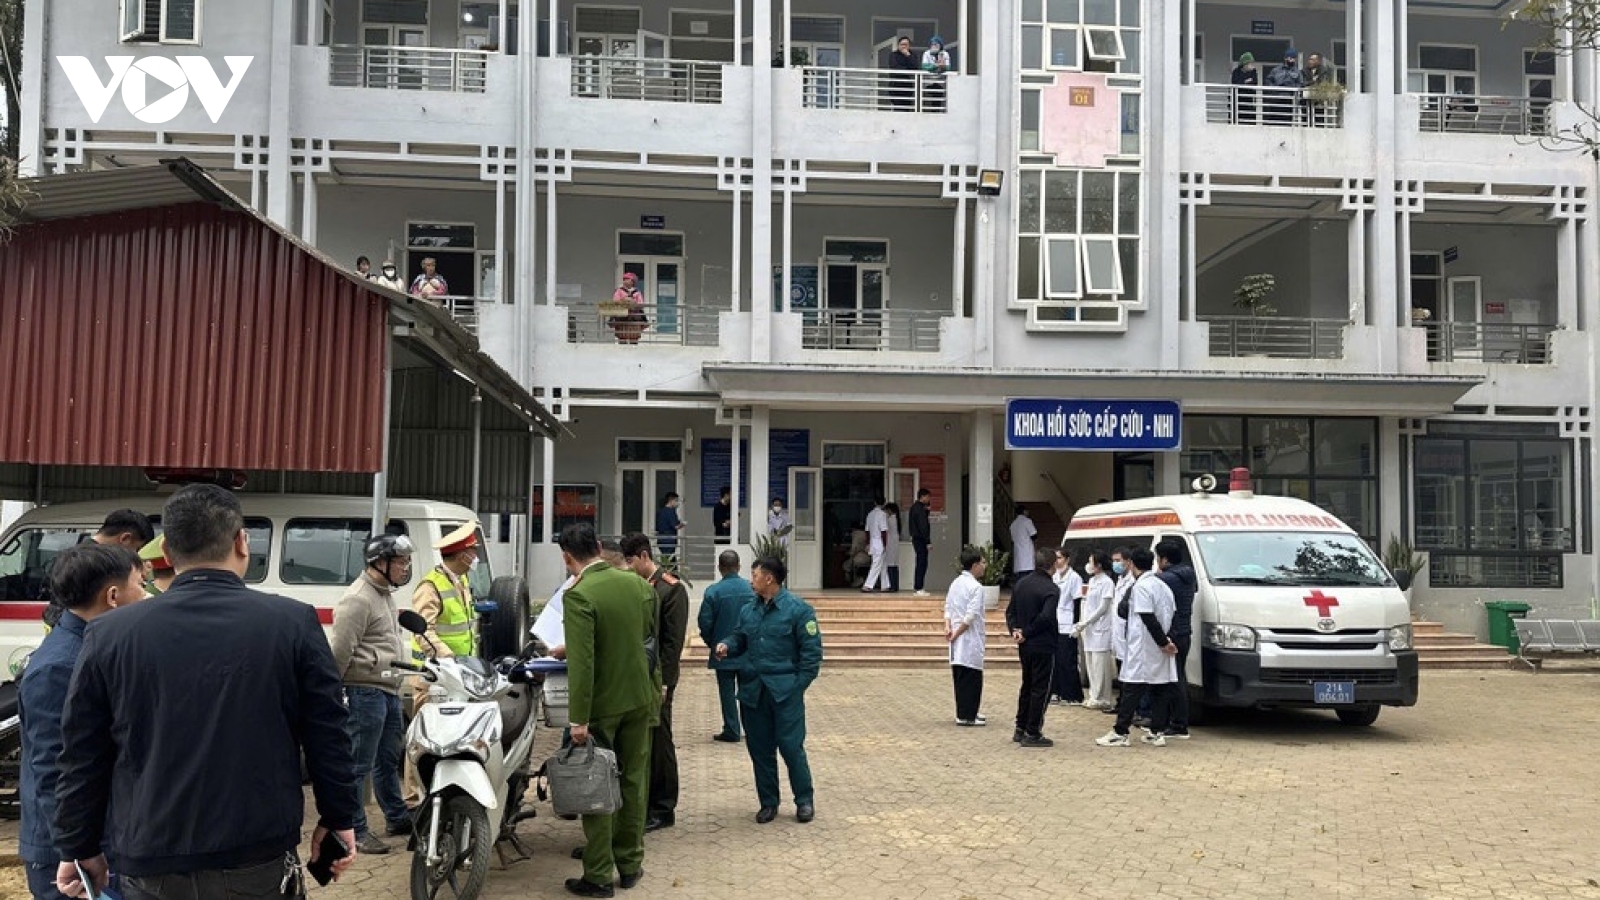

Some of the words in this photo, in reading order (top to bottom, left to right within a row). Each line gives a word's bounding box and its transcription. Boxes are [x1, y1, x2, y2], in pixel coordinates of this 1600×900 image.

[1014, 413, 1045, 436] KHOA
[1068, 408, 1092, 438] SỨC
[1094, 405, 1118, 438] CẤP
[1120, 408, 1143, 438] CỨU
[1153, 413, 1174, 438] NHI
